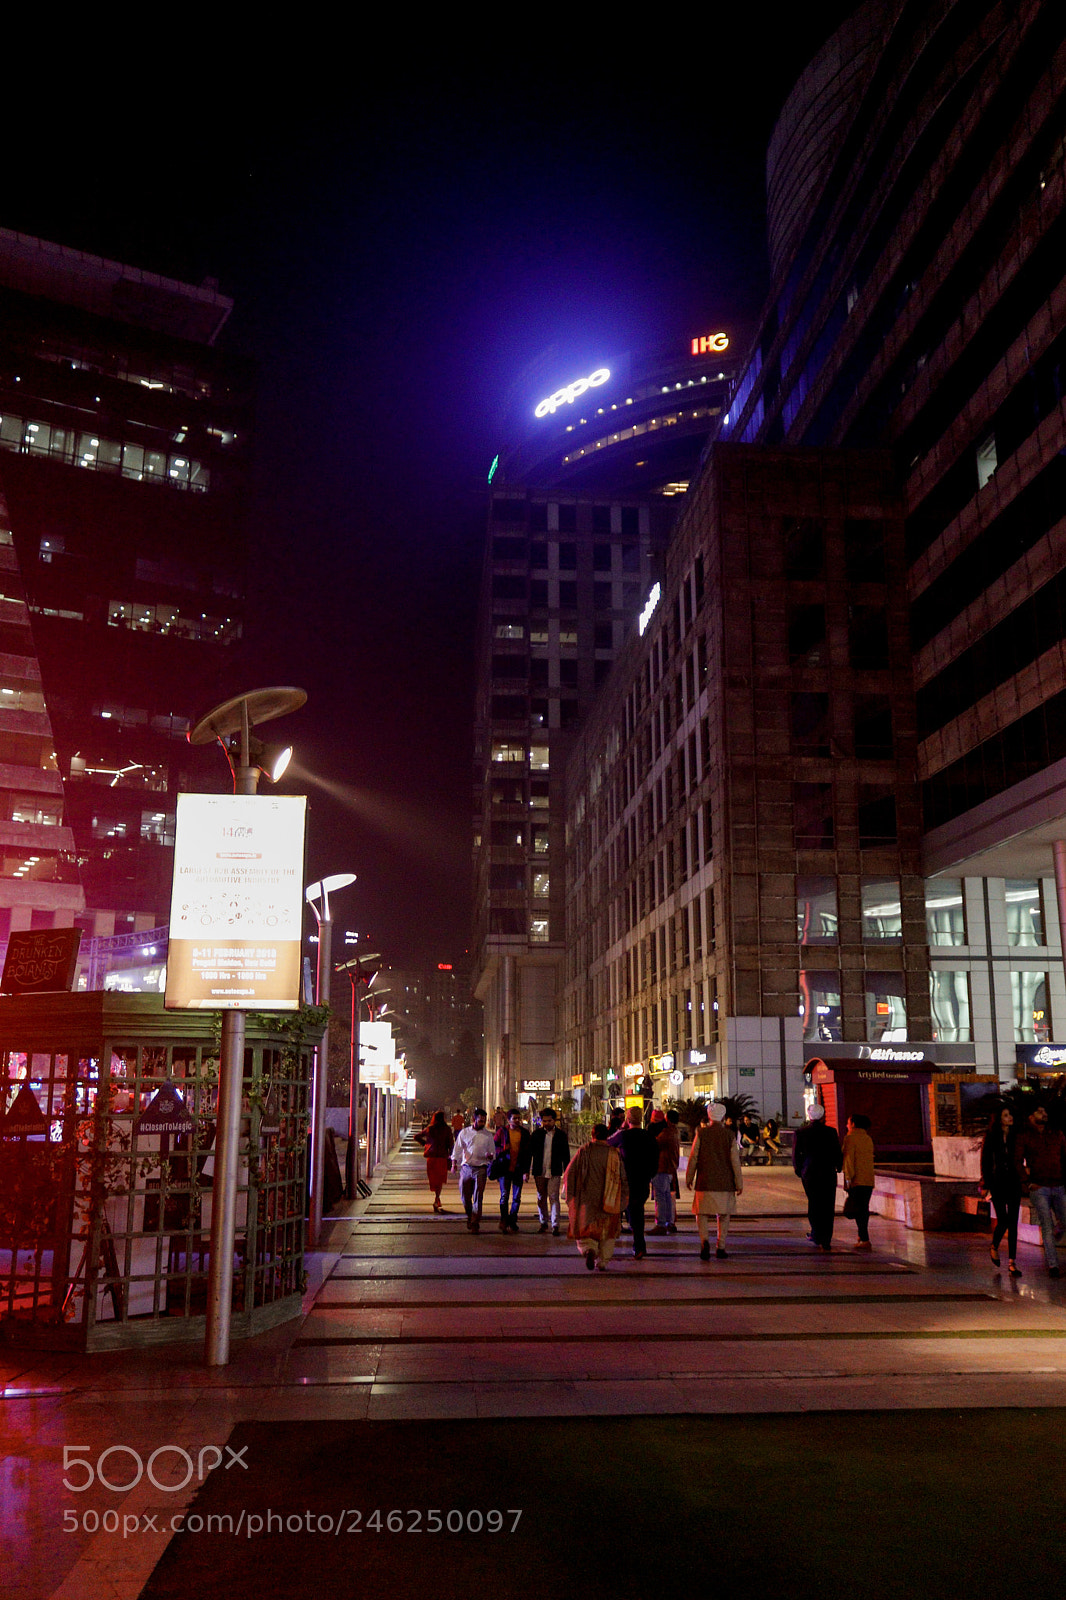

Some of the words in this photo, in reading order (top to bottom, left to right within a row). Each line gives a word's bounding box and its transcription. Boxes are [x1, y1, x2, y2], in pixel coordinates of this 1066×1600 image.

[691, 332, 729, 355] IHG
[534, 368, 611, 419] oppo
[283, 868, 295, 876] THE
[11, 944, 64, 960] DRUNKEN
[213, 948, 256, 958] FEBRUARY
[6, 960, 66, 982] BOTANIST
[140, 1121, 193, 1133] #CloserToMagic
